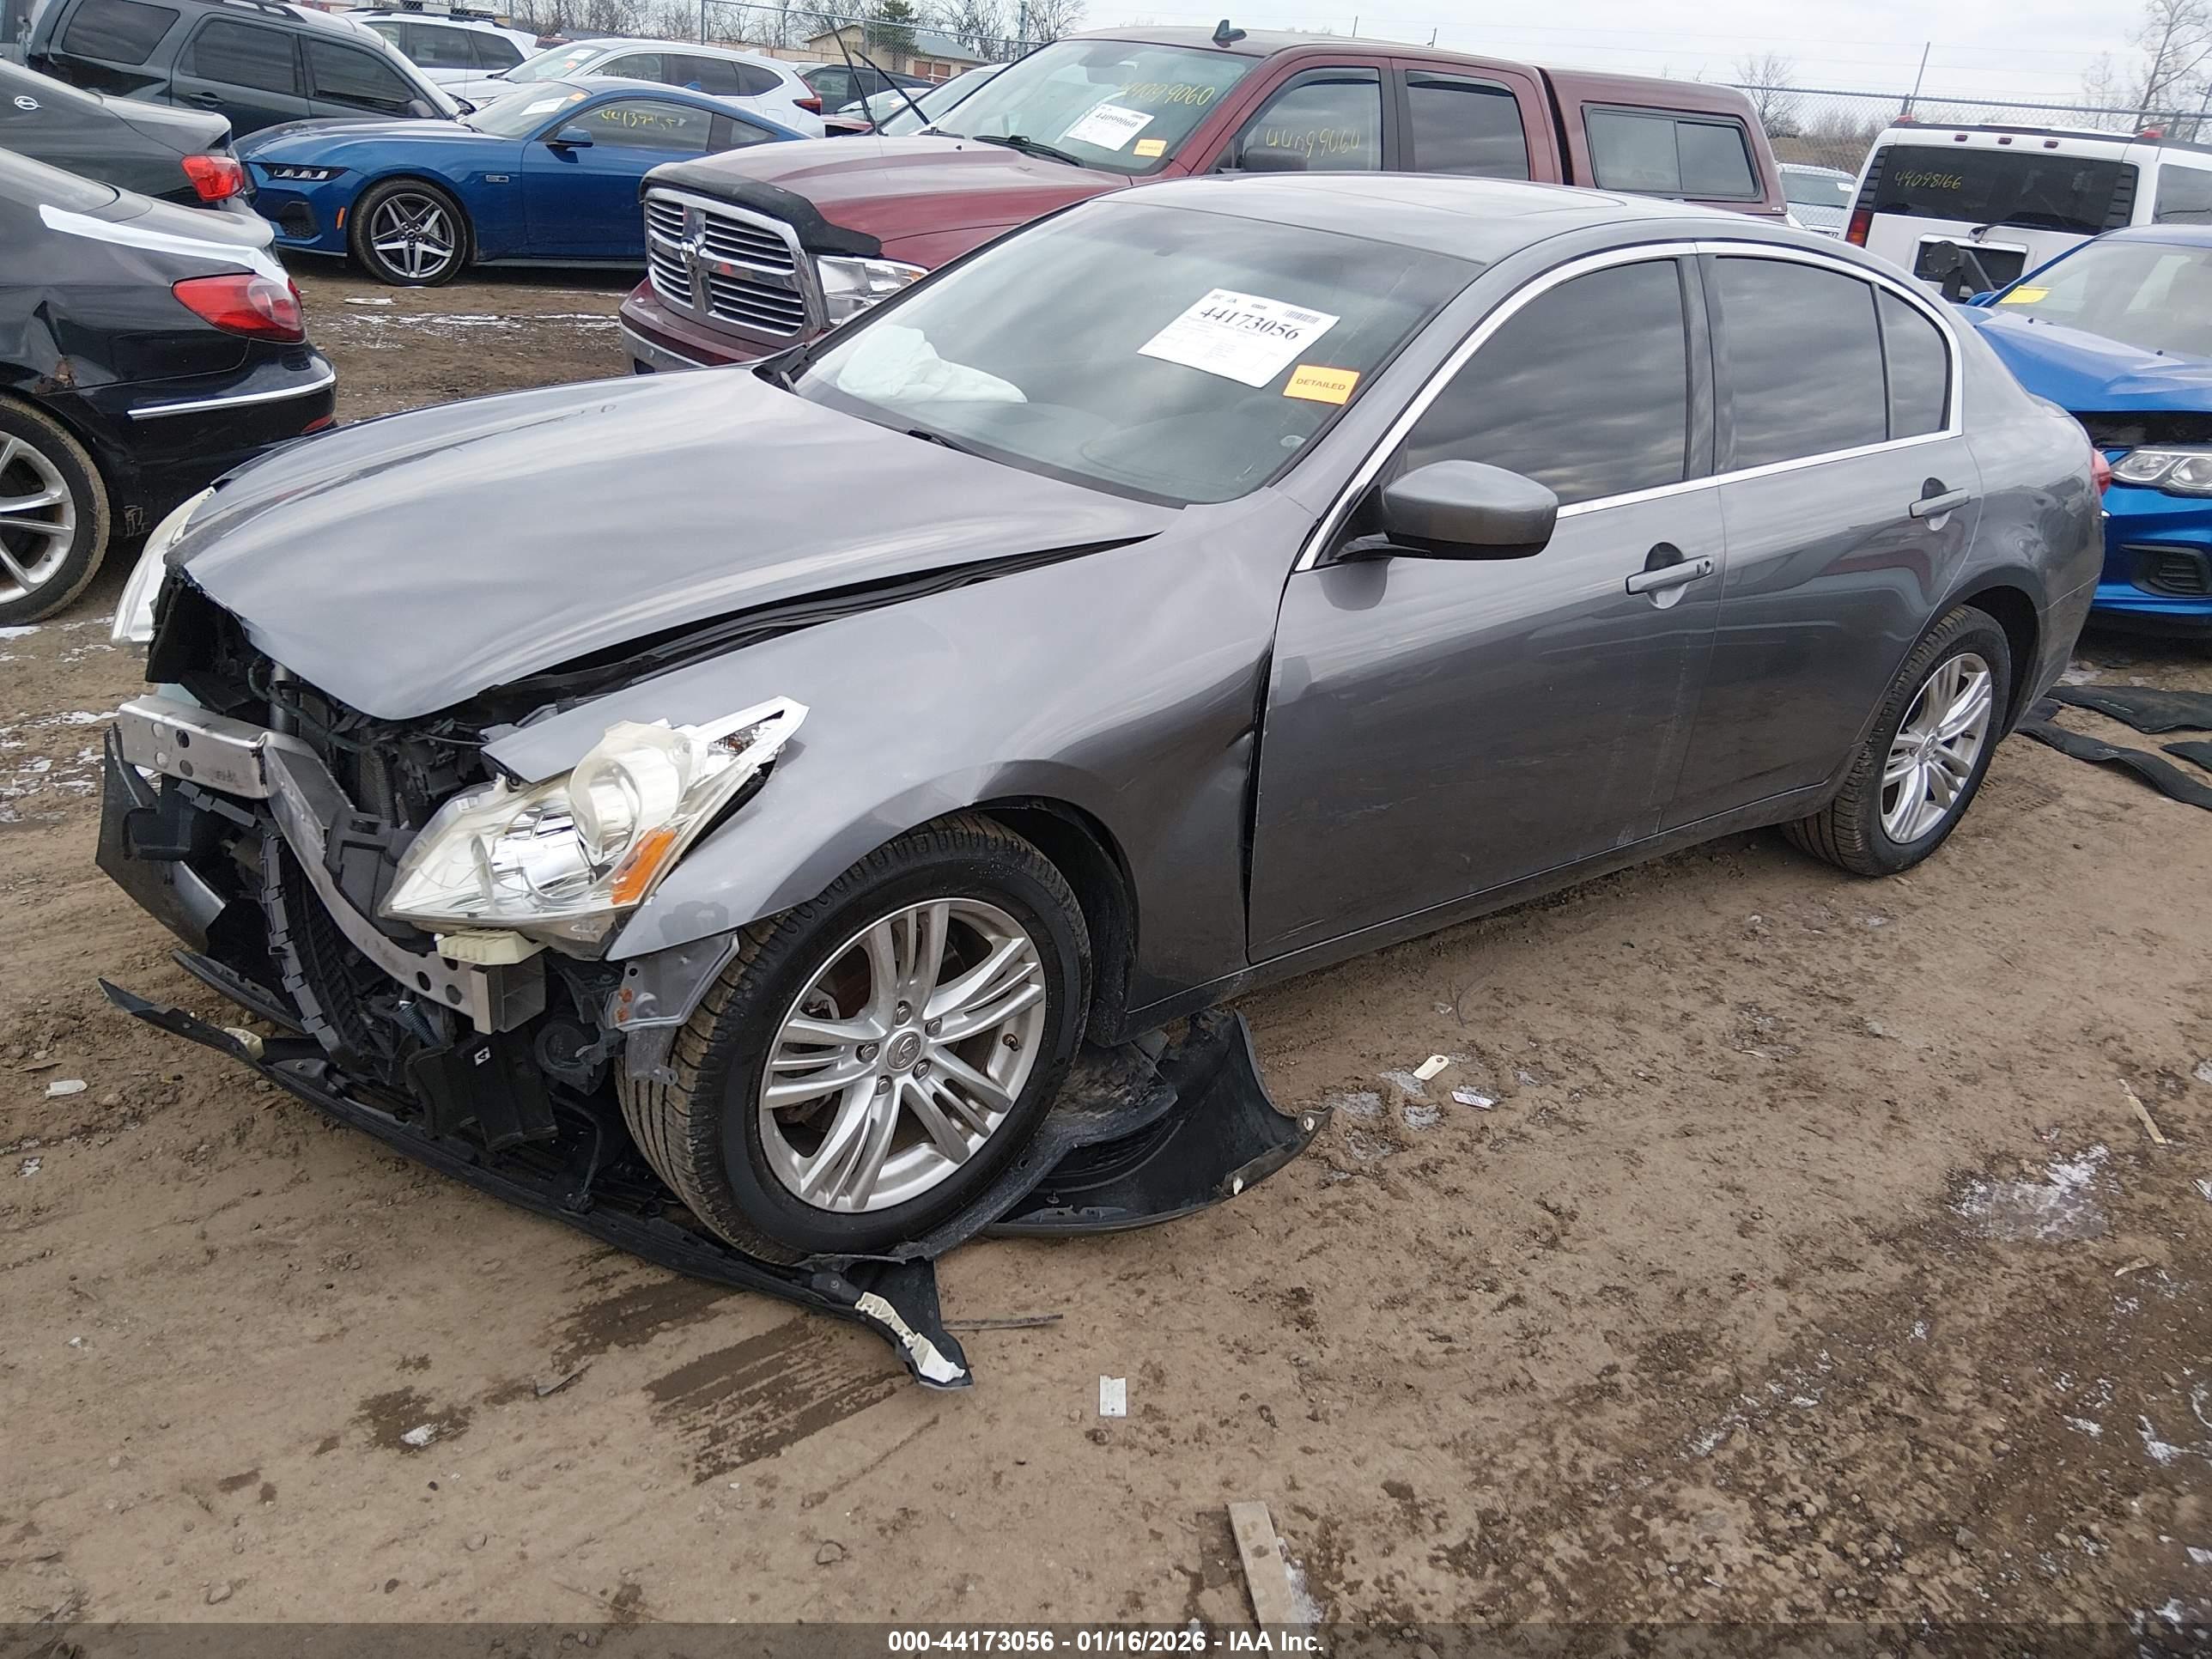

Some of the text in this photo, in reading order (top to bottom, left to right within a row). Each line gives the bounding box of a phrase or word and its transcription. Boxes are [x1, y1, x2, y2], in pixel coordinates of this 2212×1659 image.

[1894, 171, 1963, 190] 44098166
[1200, 306, 1304, 341] 44173056
[1296, 378, 1347, 391] DETAILED
